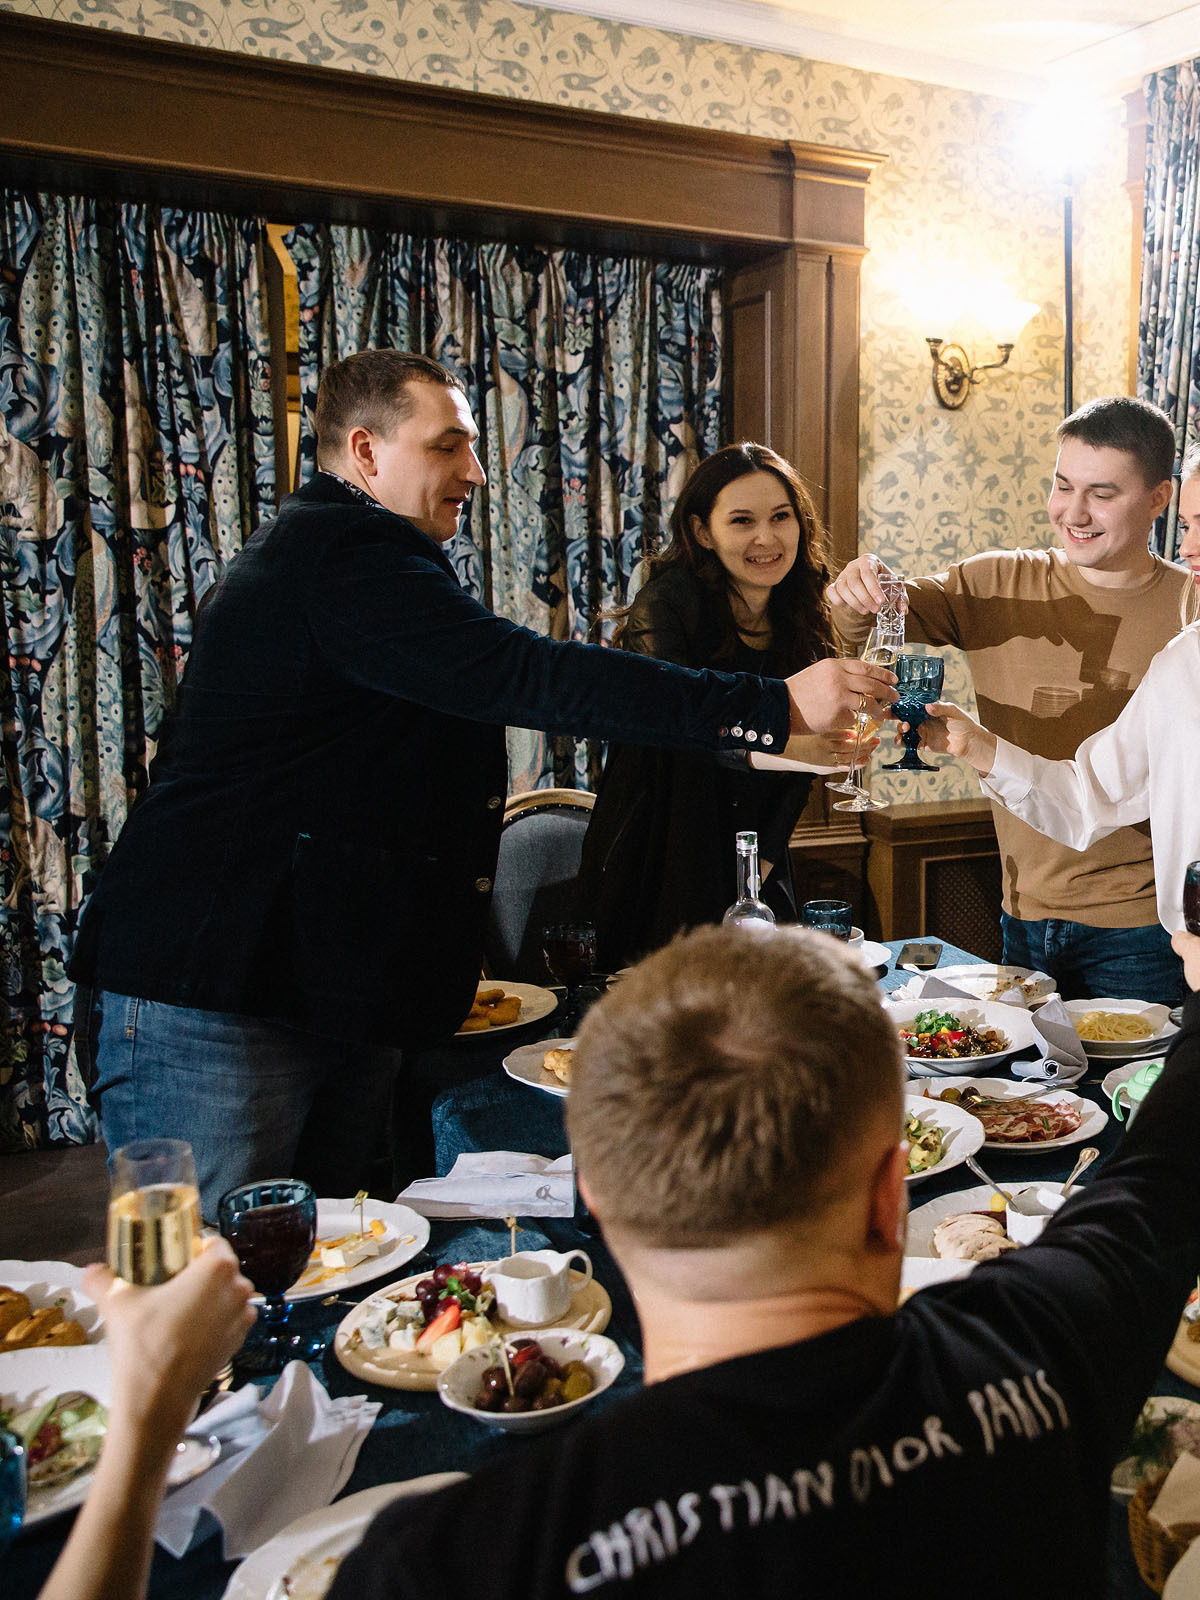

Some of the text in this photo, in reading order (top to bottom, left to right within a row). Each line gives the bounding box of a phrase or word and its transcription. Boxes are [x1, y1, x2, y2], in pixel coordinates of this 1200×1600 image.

[565, 1368, 1070, 1595] CHRISTIAN DIOR PARIS
